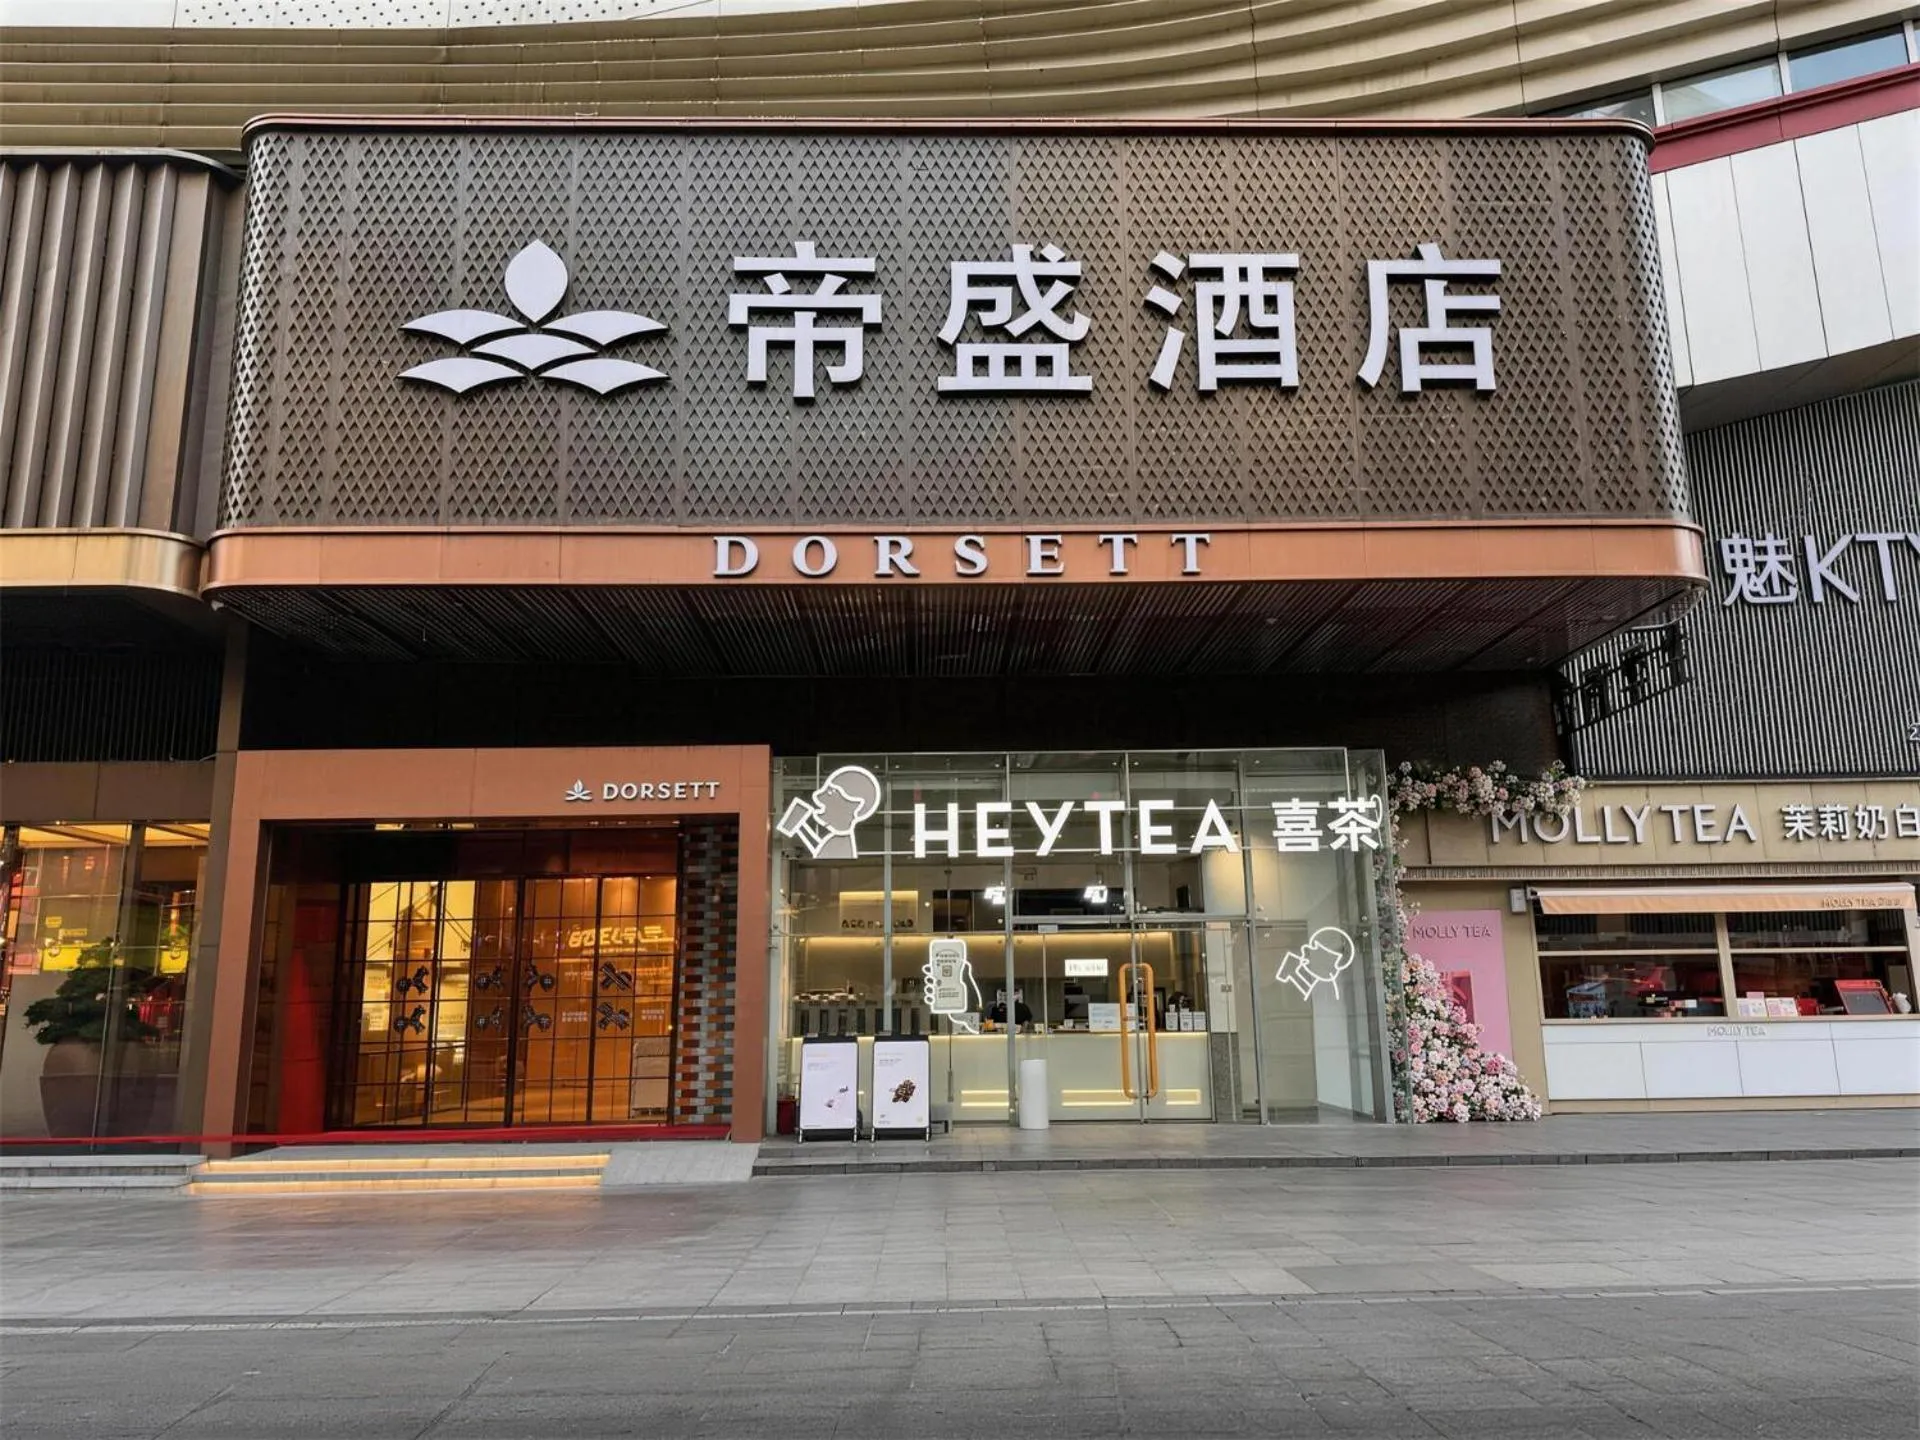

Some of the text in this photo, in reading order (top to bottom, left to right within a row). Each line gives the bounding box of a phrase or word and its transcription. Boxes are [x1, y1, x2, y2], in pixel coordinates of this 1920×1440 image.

[728, 241, 1502, 399] 帝盛酒店
[712, 534, 1211, 577] DORSETT
[602, 781, 721, 800] DORSETT
[913, 797, 1380, 859] HEYTEA 喜茶
[1491, 802, 1920, 844] MOLLY TEA 茉莉奶白
[1412, 924, 1492, 939] MOLLY TEA
[1706, 1024, 1767, 1037] MOLLY TEA
